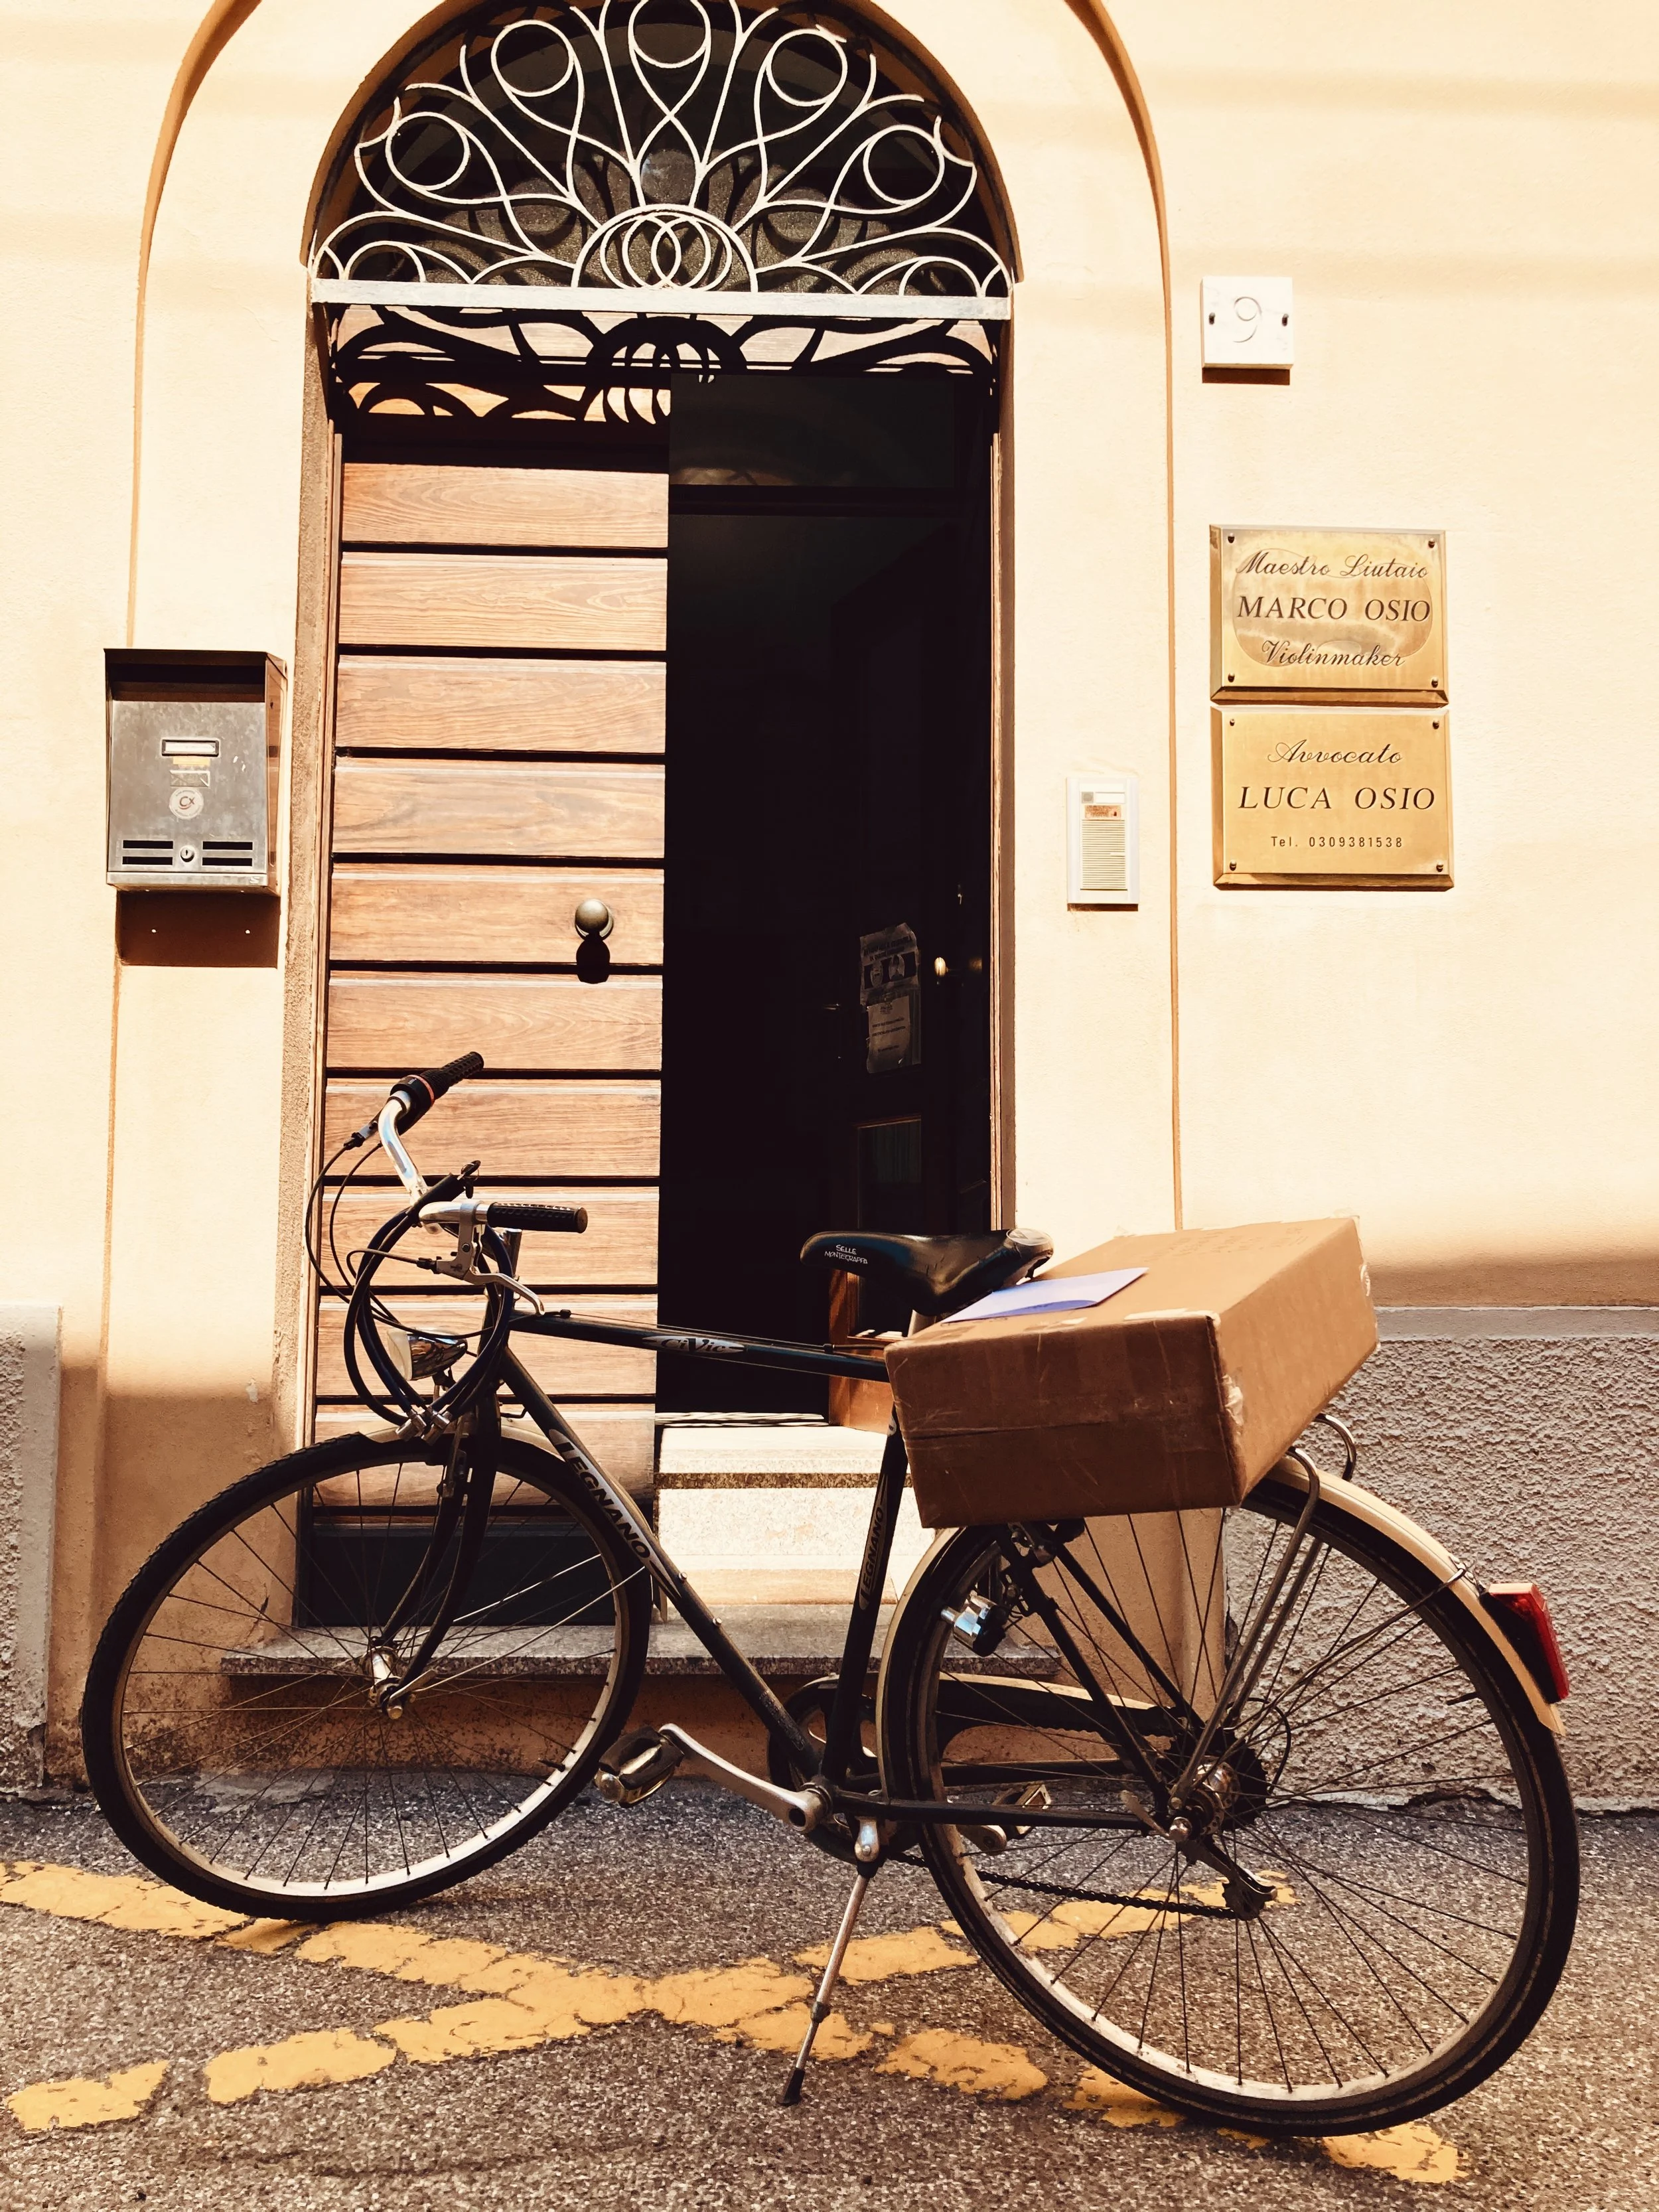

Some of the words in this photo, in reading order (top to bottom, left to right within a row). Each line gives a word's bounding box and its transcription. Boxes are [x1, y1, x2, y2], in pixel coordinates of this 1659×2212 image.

[1233, 296, 1262, 343] 9
[1236, 550, 1331, 576] Maestro
[1340, 553, 1429, 579] Liutaio
[1236, 595, 1348, 620] MARCO
[1364, 599, 1431, 622] OSIO
[1261, 640, 1406, 667] Violinmaker
[1267, 739, 1404, 764] Avvocato
[1238, 786, 1333, 810] LUCA
[1354, 787, 1435, 810] OSIO
[1271, 836, 1299, 848] Tel.
[1309, 836, 1404, 848] 0309381538
[824, 1250, 868, 1264] MONTEGRAPPA
[835, 1244, 857, 1255] SELLE
[555, 1441, 651, 1559] LEGNANO
[860, 1507, 885, 1600] LEGNANO
